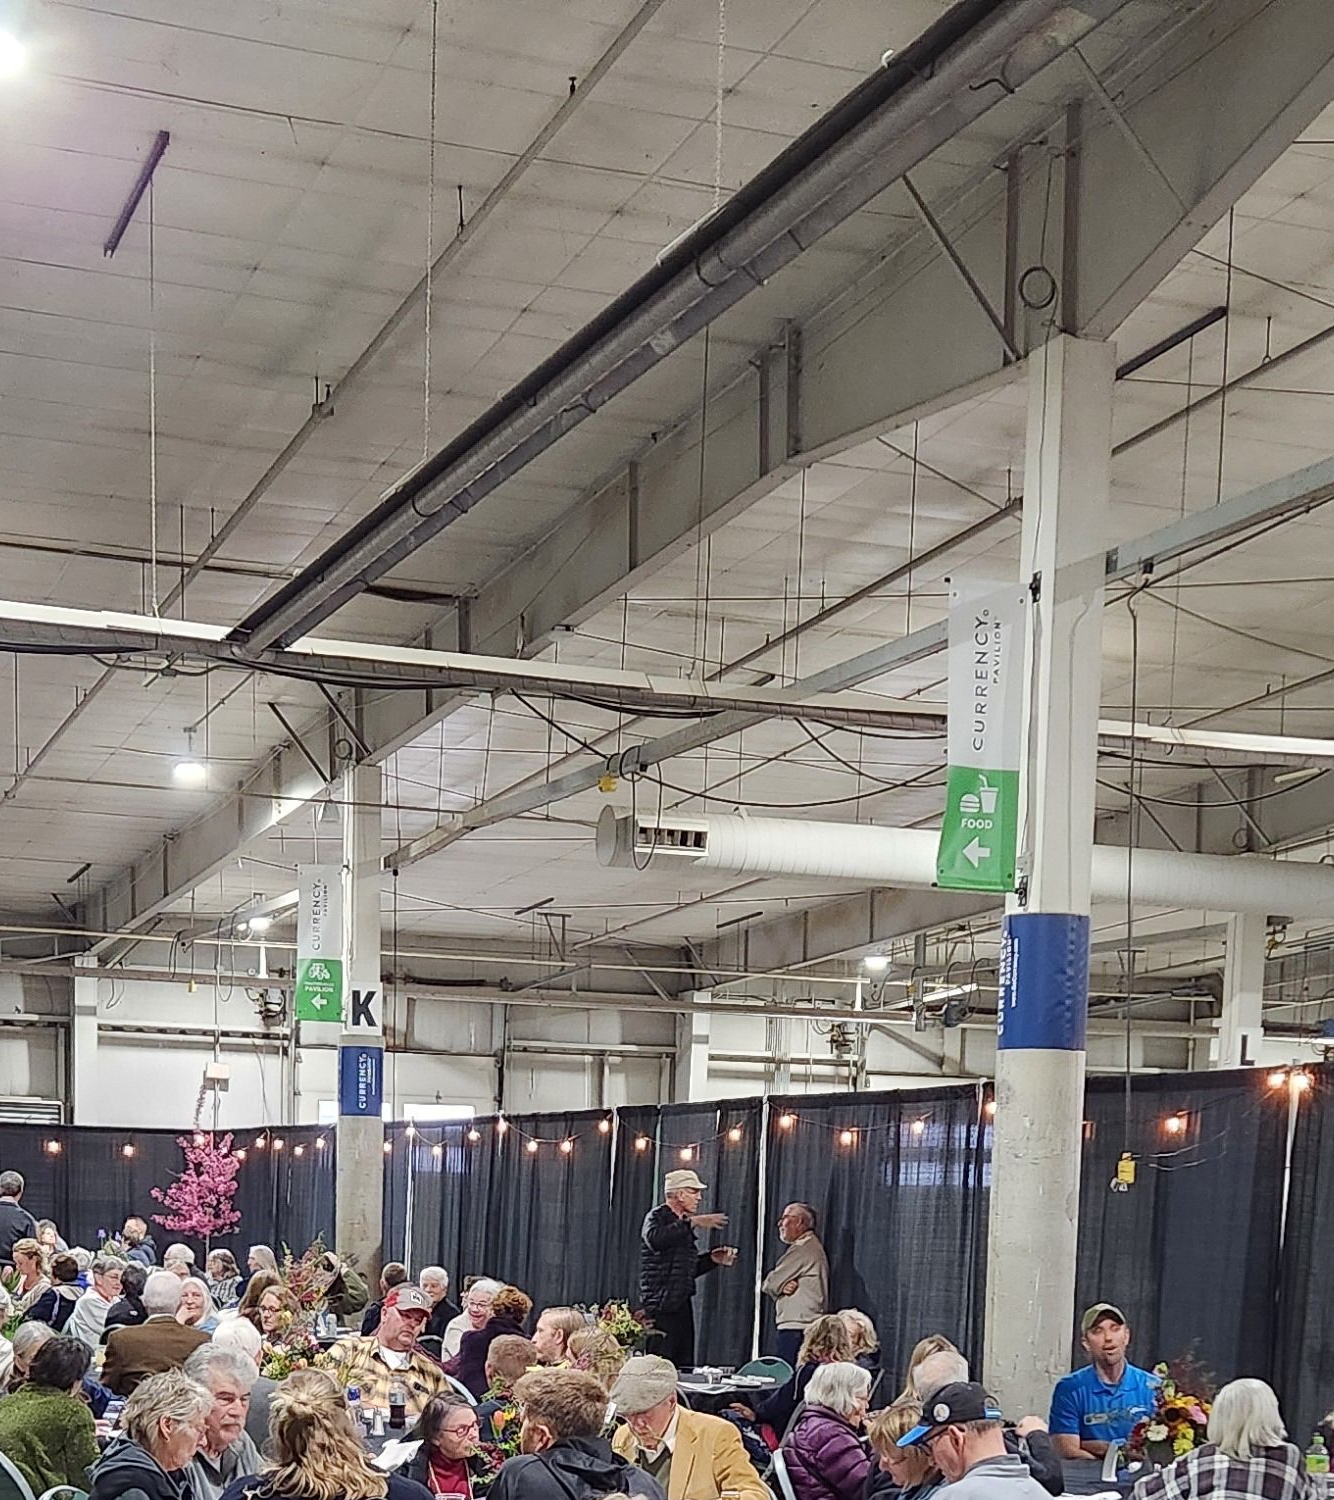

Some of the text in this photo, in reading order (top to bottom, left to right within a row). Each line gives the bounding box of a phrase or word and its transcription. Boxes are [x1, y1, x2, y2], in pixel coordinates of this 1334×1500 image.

[992, 621, 1002, 684] PAVILION
[971, 611, 990, 752] CURRENCY
[961, 818, 993, 830] FOOD
[312, 880, 321, 951] CURRENCY
[352, 990, 378, 1027] K
[1240, 1034, 1255, 1066] L
[358, 1054, 367, 1109] CURRENCY
